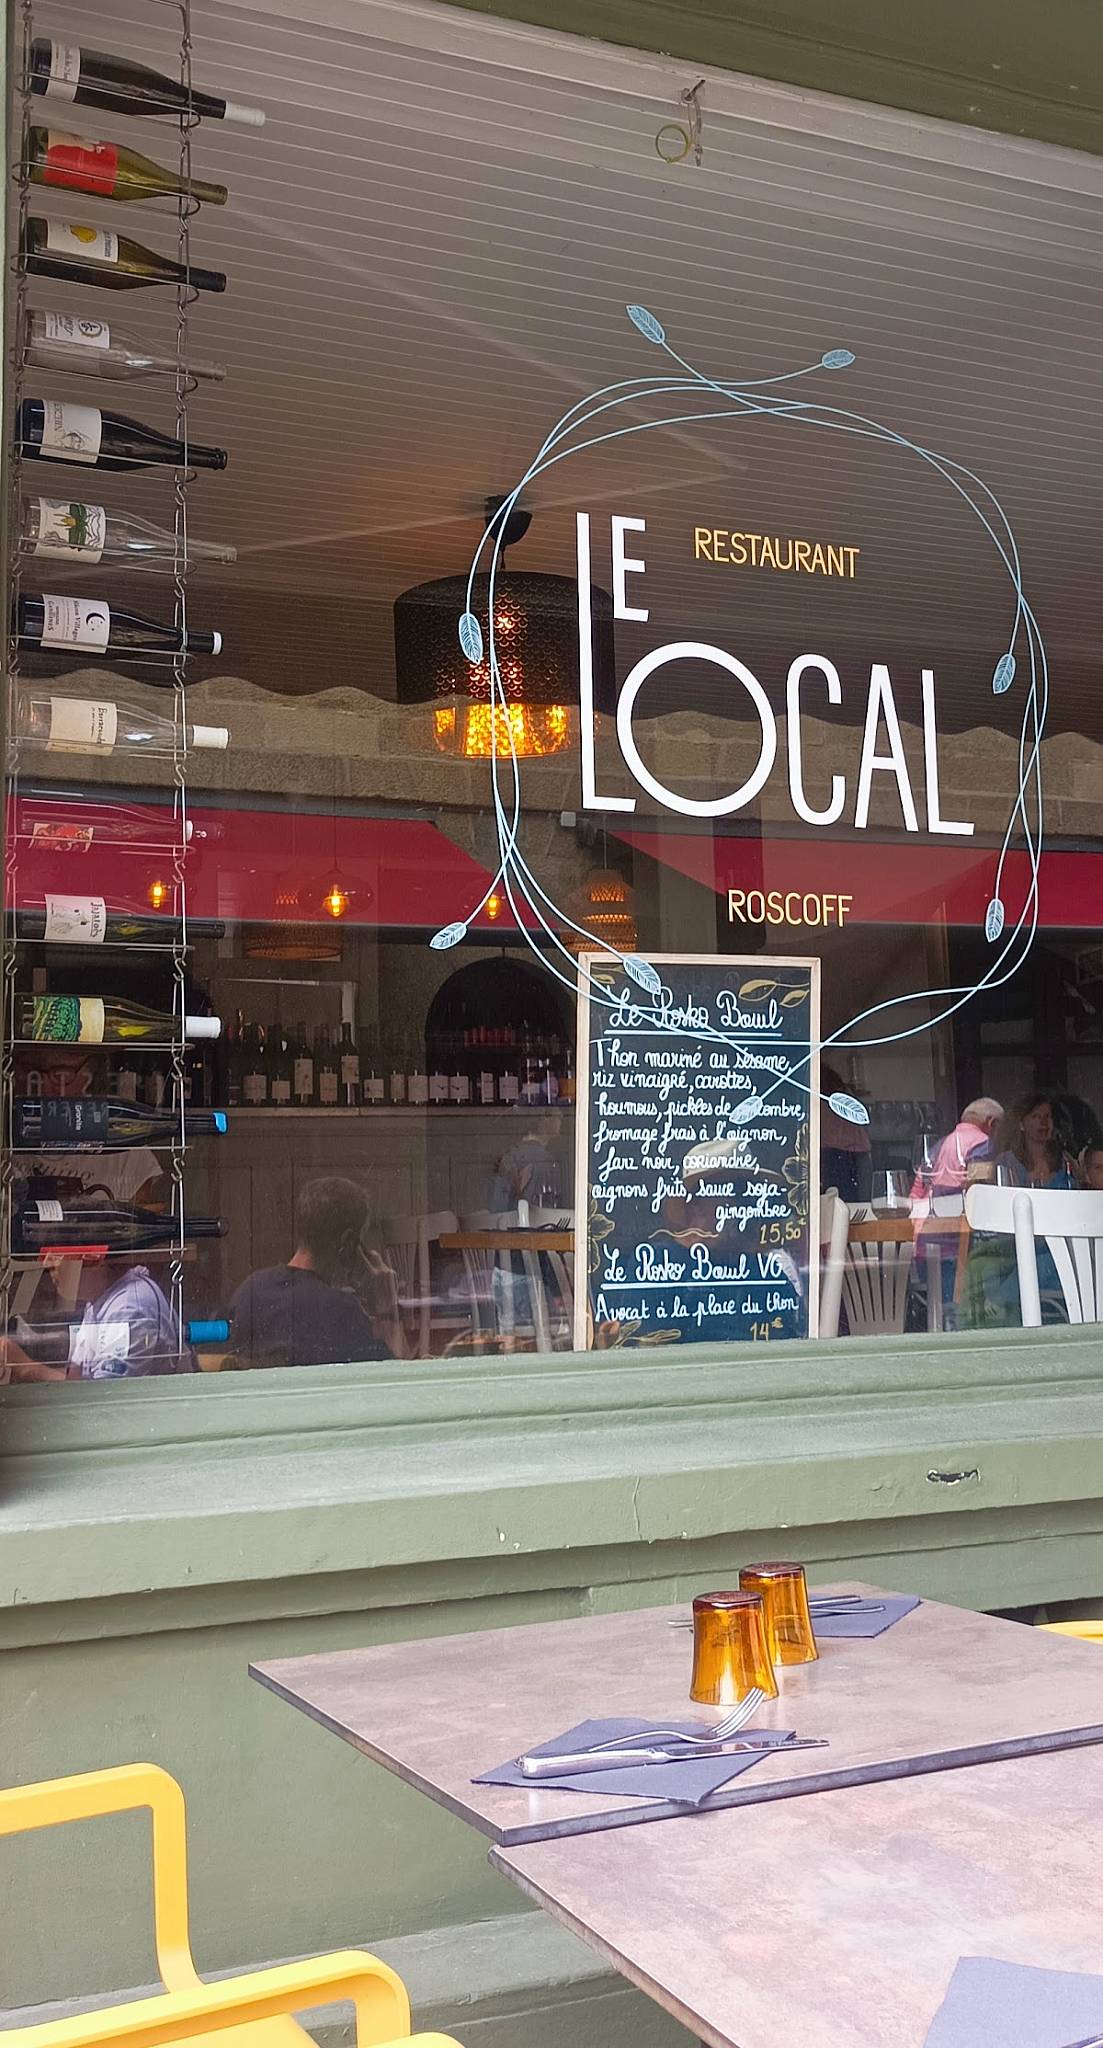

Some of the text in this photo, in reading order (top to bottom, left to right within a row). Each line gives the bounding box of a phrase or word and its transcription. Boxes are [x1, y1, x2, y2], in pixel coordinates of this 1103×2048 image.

[694, 527, 860, 578] RESTAURANT
[576, 511, 976, 837] LOCAL
[727, 888, 854, 928] ROSCOFF
[606, 984, 784, 1030] Le Rosko Bowl
[590, 1038, 640, 1069] Thon
[644, 1046, 703, 1069] mariné
[709, 1053, 730, 1069] au
[592, 1070, 757, 1100] riz vinaigré, carottes,
[594, 1091, 663, 1123] houmous,
[664, 1096, 713, 1128] pickles
[714, 1096, 731, 1116] de
[592, 1120, 658, 1155] fromage
[658, 1121, 697, 1154] frais
[699, 1125, 710, 1140] à
[641, 1155, 680, 1176] noir,
[683, 1150, 760, 1174] coriandre,
[592, 1176, 788, 1213] oignons frits, sauce soja-
[603, 1242, 783, 1281] Le Rosko Bowl VG
[594, 1292, 800, 1327] Avocat à la place du thon
